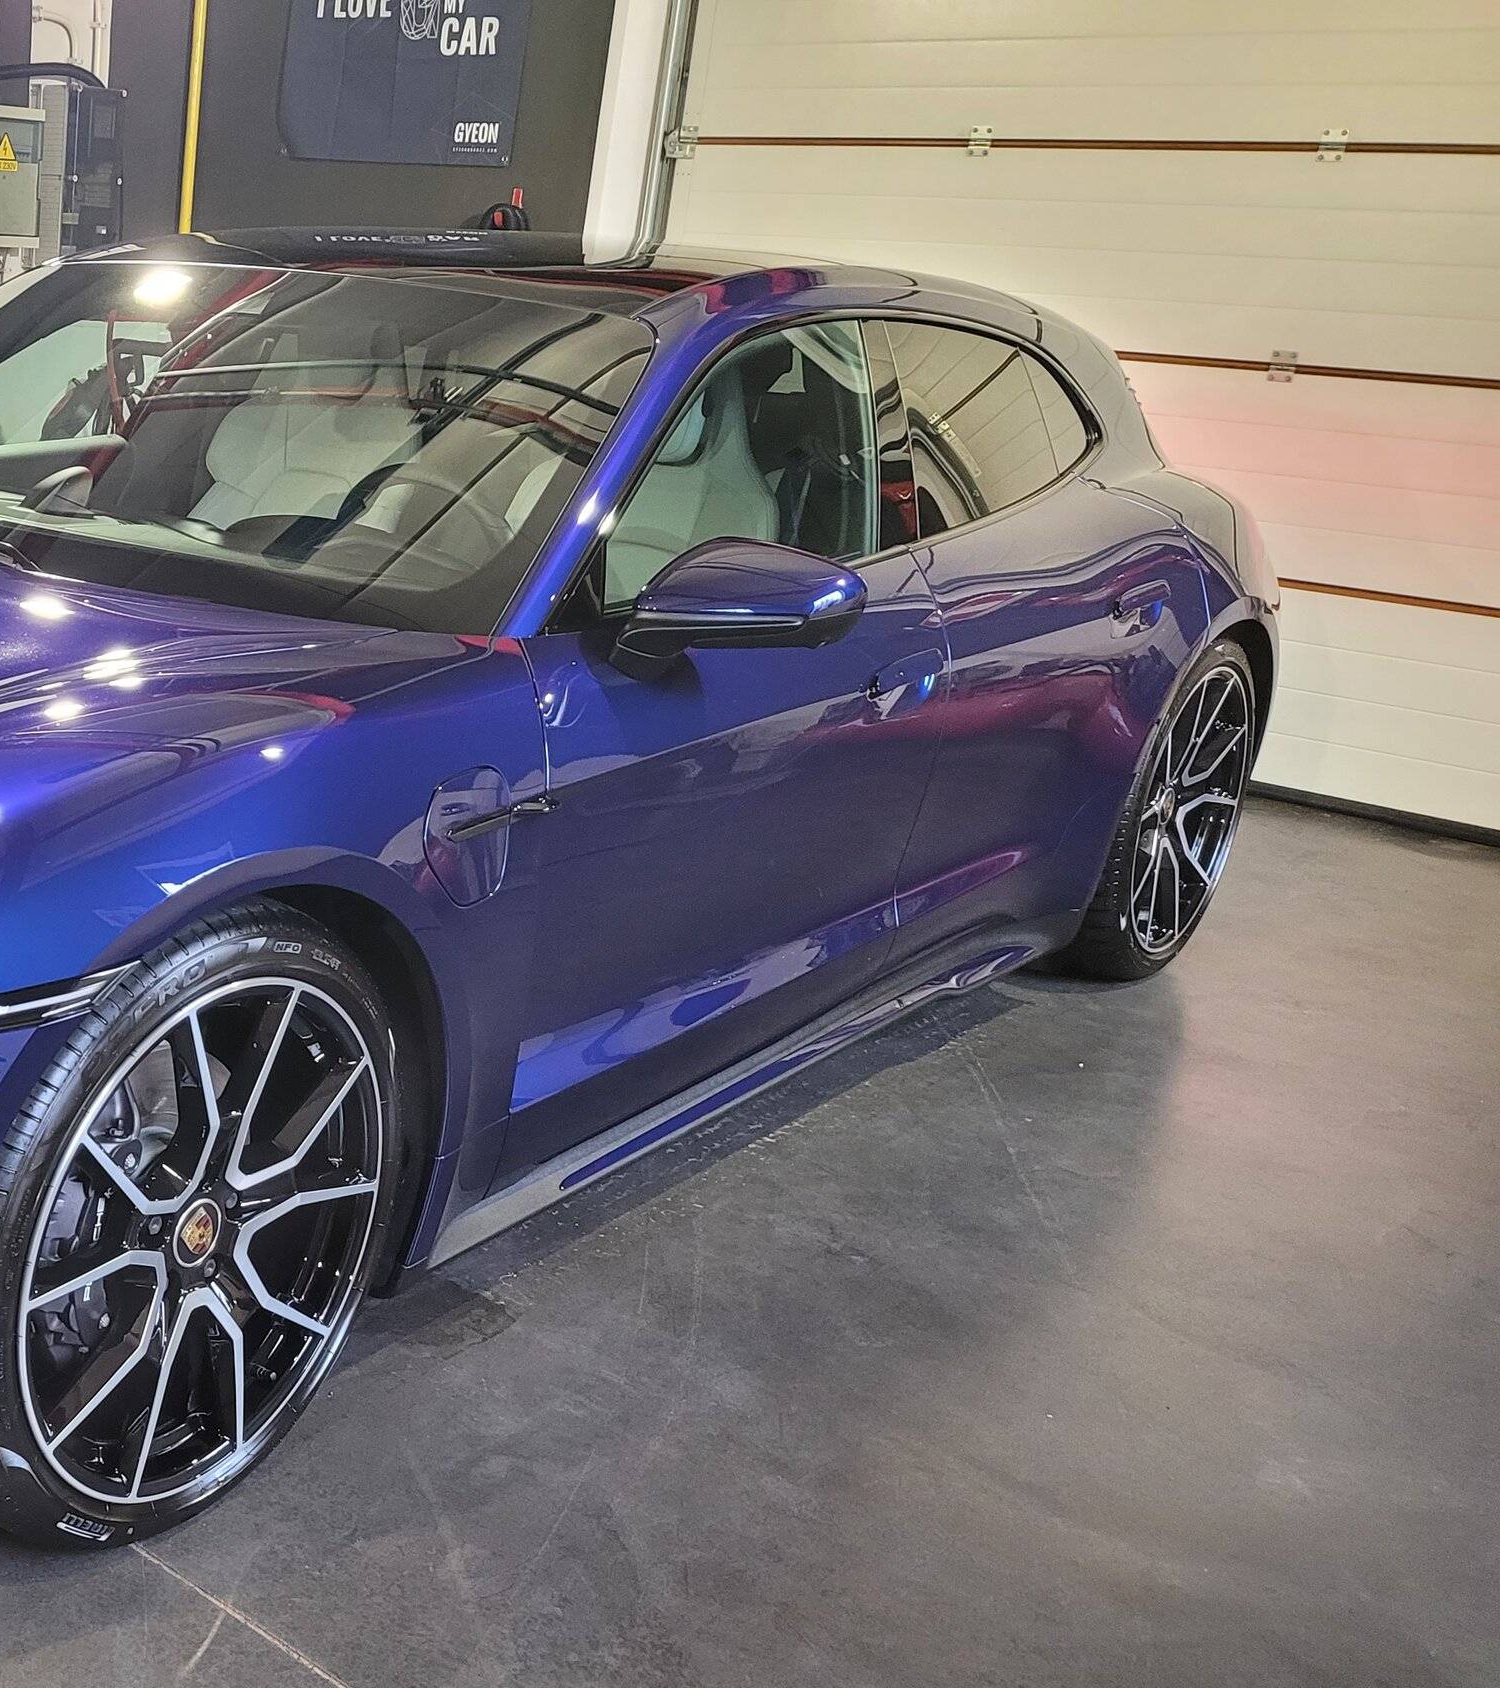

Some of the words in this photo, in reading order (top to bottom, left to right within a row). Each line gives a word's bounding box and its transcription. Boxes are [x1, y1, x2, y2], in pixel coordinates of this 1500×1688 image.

[316, 0, 325, 18] I
[333, 0, 392, 18] LOVE
[443, 0, 466, 14] MY
[440, 16, 500, 56] CAR
[453, 122, 500, 144] GYEON
[275, 942, 301, 952] NFO
